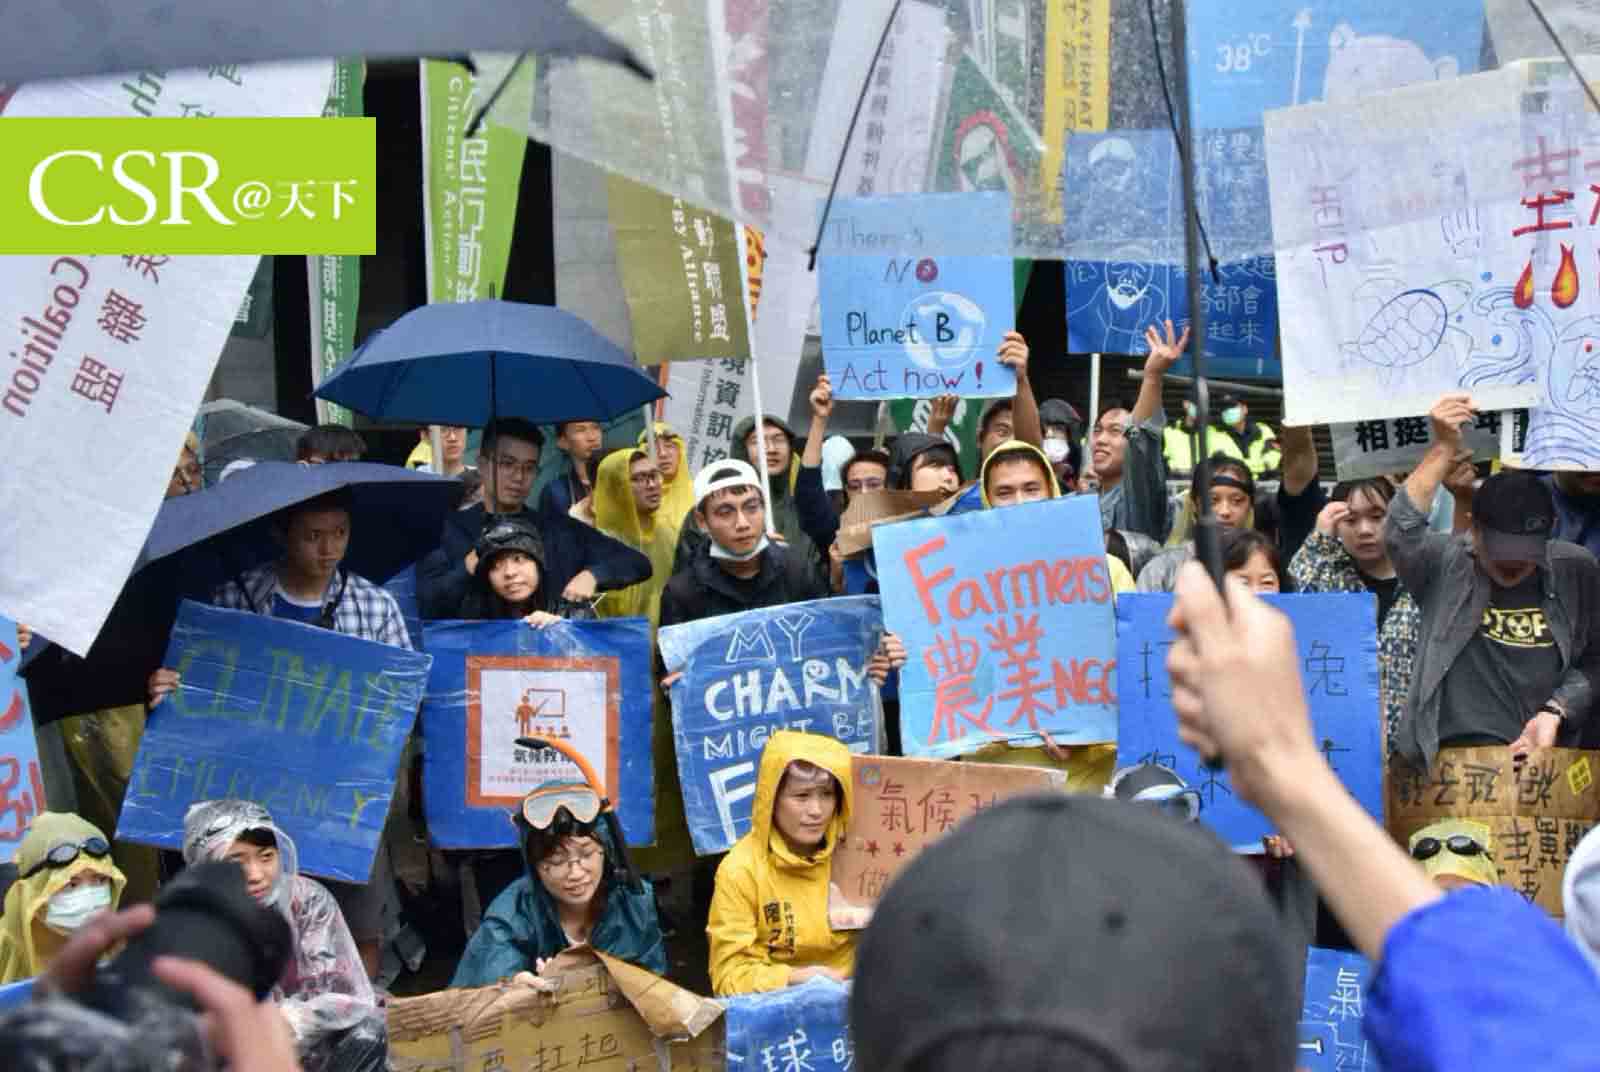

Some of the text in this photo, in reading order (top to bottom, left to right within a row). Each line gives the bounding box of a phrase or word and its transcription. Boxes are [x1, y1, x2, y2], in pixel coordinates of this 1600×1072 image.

[846, 311, 954, 346] Planet B
[839, 360, 889, 393] Act
[1354, 417, 1430, 453] 相挺
[904, 535, 1110, 626] Farmers
[725, 614, 815, 663] MY
